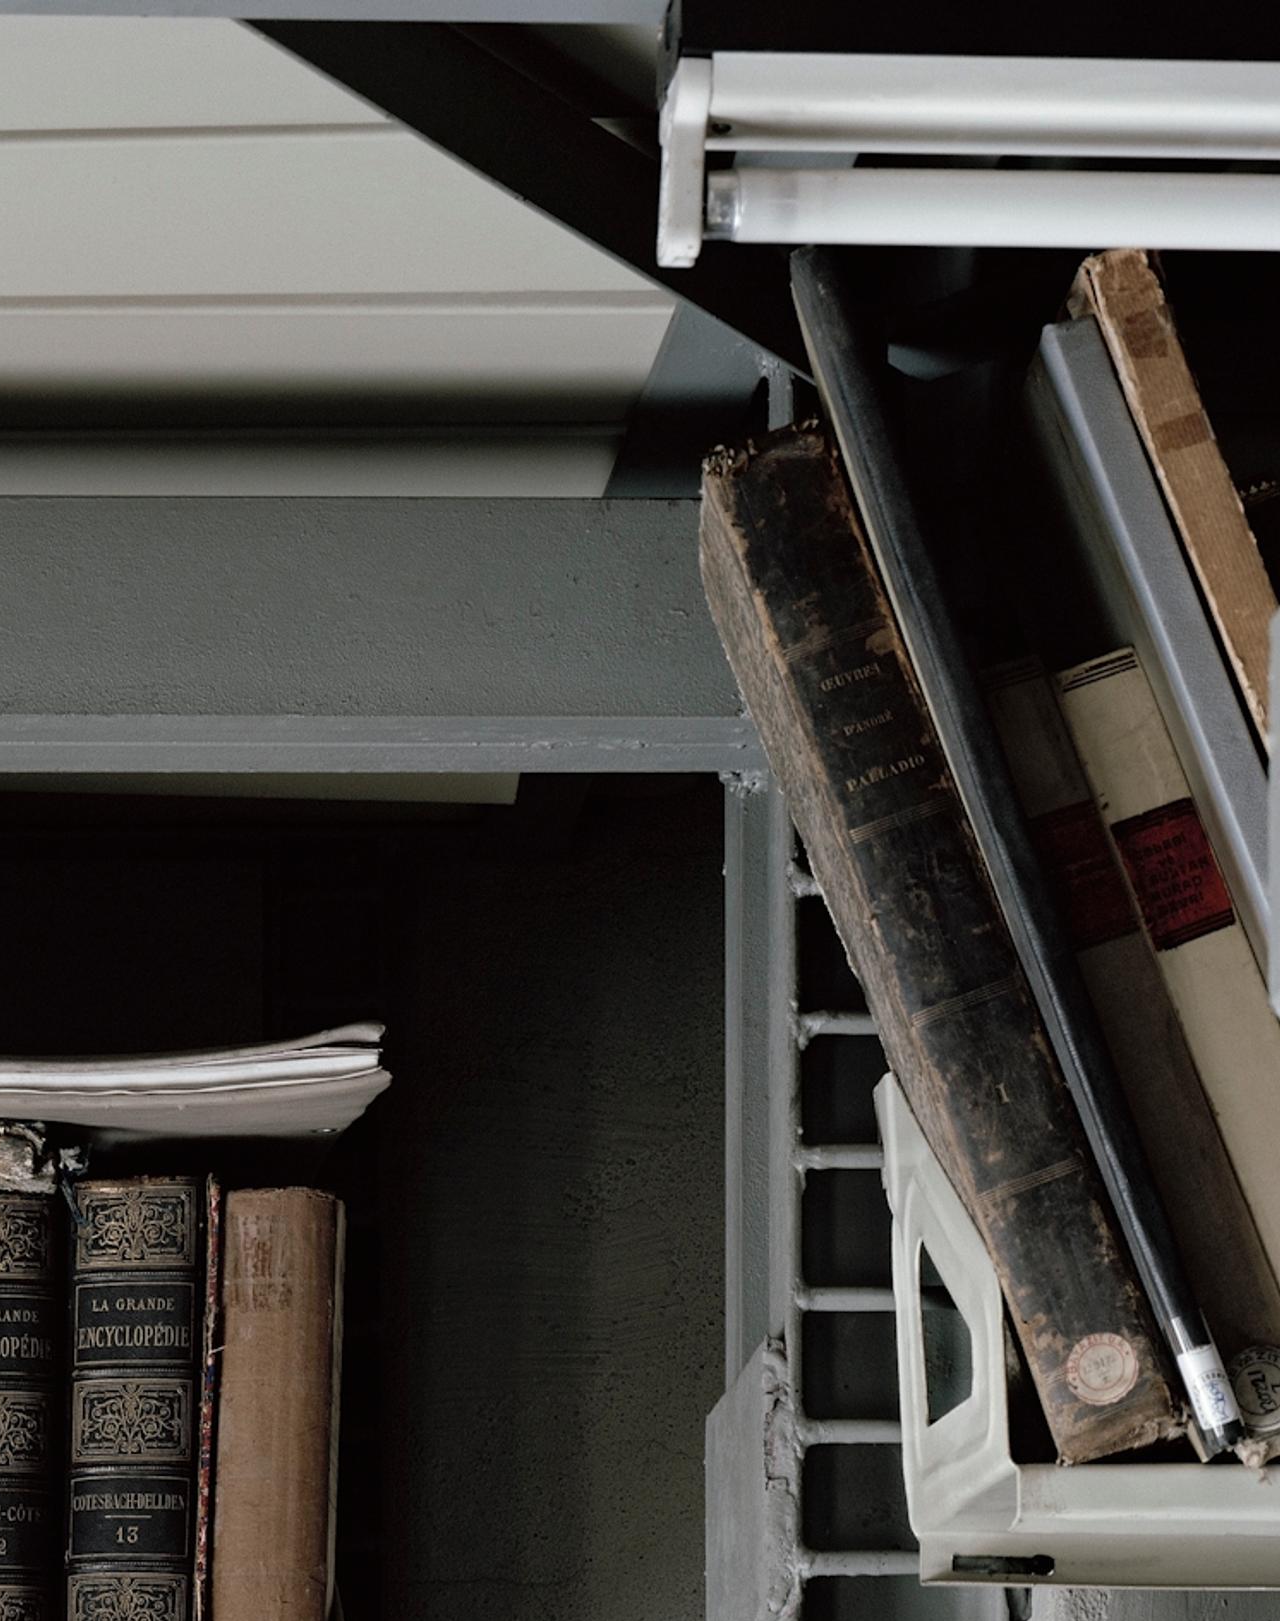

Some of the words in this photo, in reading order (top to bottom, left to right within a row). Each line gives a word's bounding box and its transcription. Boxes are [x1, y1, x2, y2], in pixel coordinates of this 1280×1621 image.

[845, 753, 926, 793] PALLADIO
[91, 1298, 110, 1313] LA
[115, 1297, 176, 1312] GRANDE
[77, 1321, 190, 1349] ENCYCLOPÉDIE
[115, 1525, 139, 1544] 13
